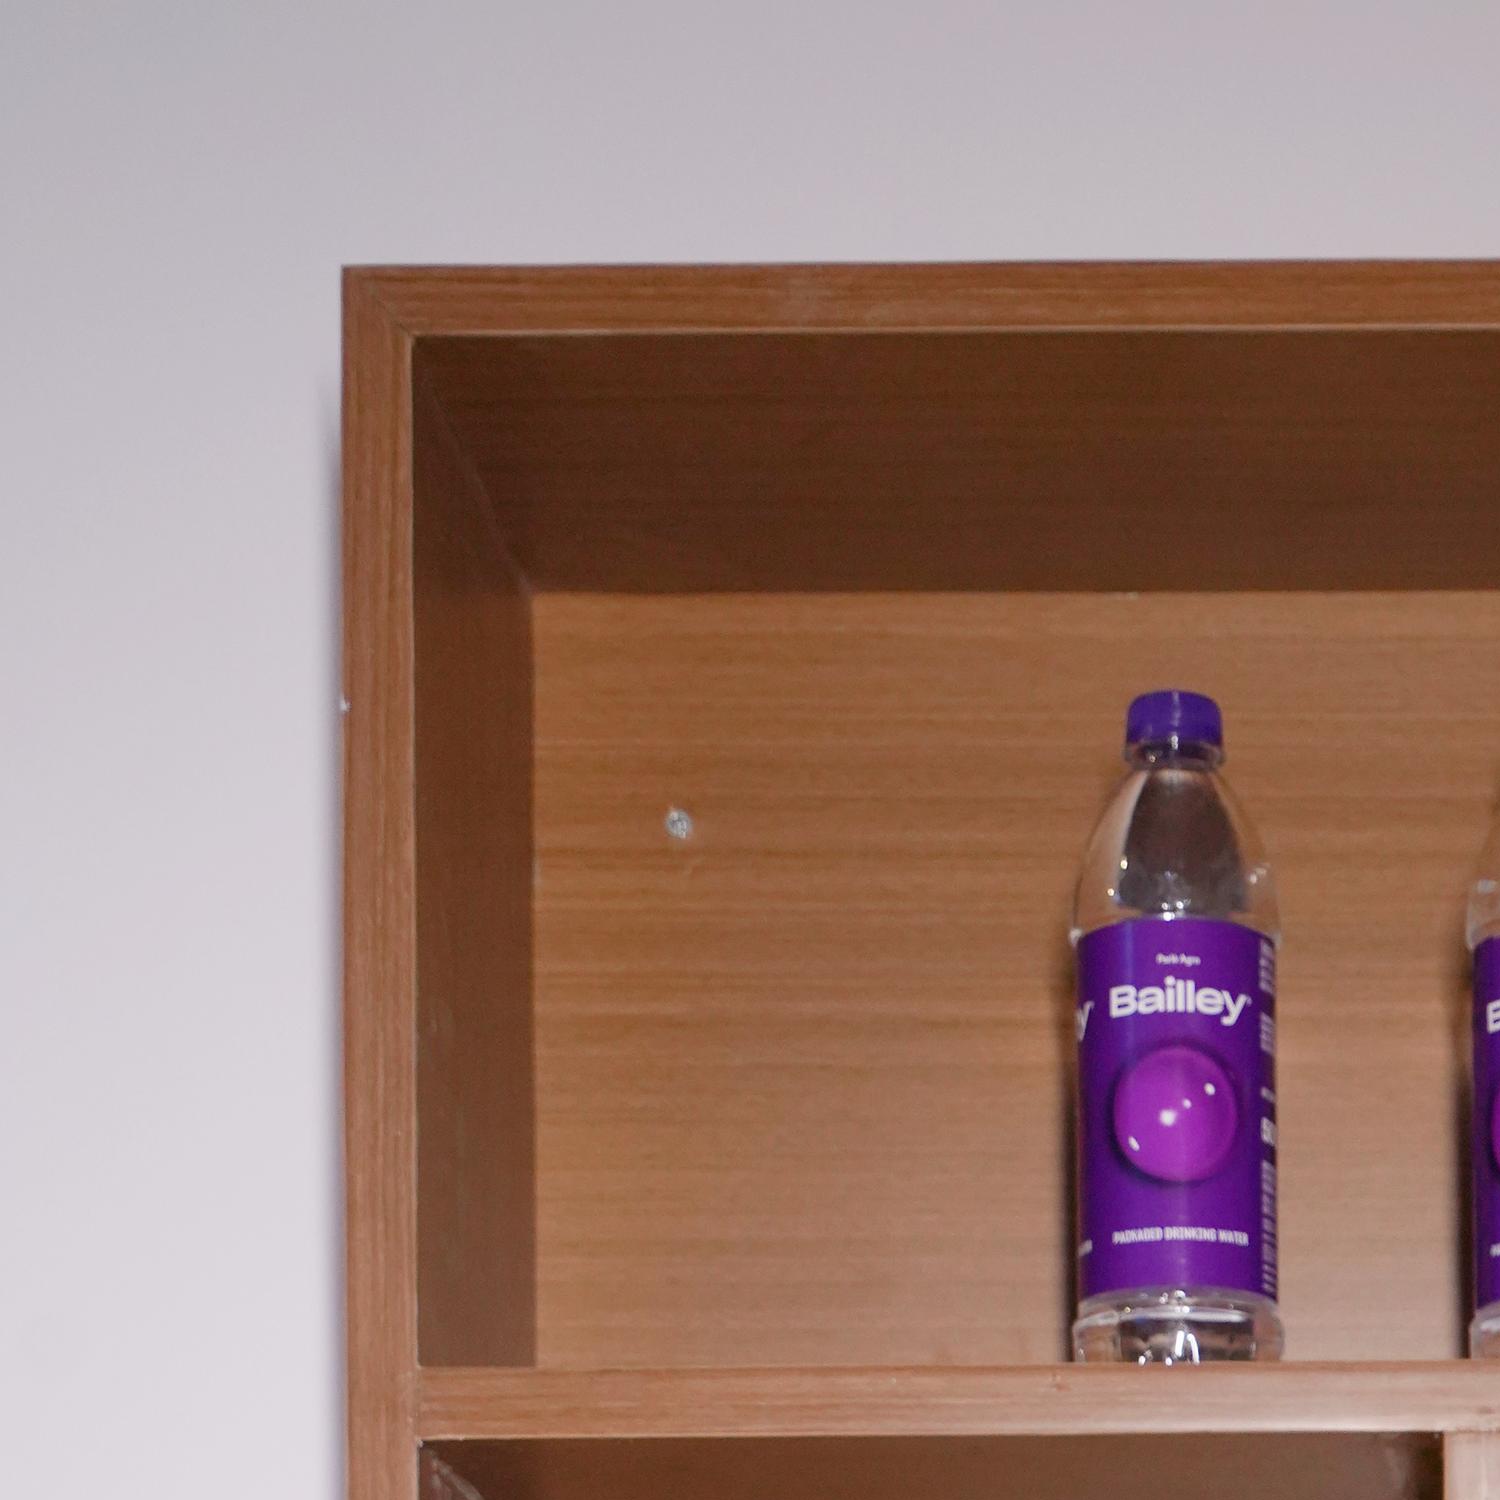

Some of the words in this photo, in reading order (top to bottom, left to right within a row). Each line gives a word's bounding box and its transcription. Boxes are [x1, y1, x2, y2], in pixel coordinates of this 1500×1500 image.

[1109, 975, 1247, 1026] Bailley
[1163, 1226, 1217, 1242] DRINKING
[1218, 1229, 1249, 1246] WATER
